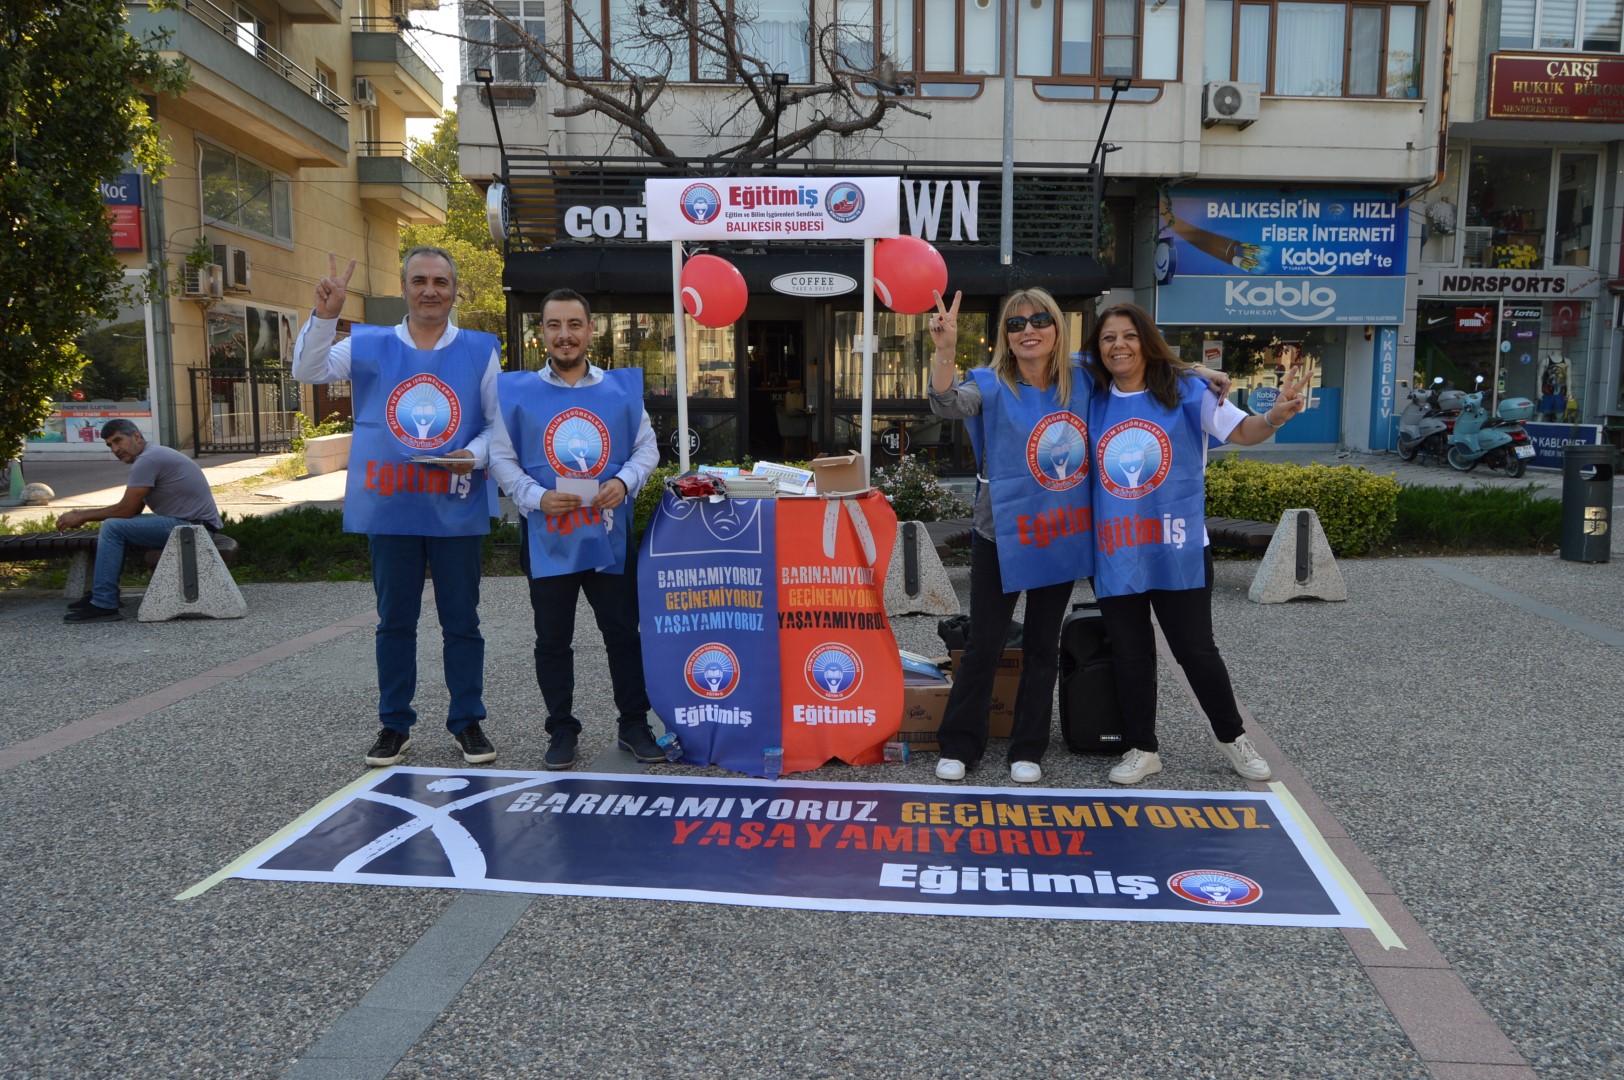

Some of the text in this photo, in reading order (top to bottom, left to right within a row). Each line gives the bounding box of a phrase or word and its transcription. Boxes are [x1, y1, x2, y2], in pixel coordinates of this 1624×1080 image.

[1546, 61, 1599, 80] ÇARŞI
[1512, 81, 1564, 94] HUKUK
[1502, 105, 1546, 113] MENDERES
[1520, 97, 1554, 105] AVUKAT
[729, 185, 818, 210] Eğitimiş
[725, 211, 743, 219] Eğitim
[1207, 198, 1396, 219] BALIKESİR'İN HIZLI
[564, 205, 647, 239] COF
[726, 218, 824, 234] BALIKESİR ŞUBESİ
[1261, 223, 1395, 242] FİBER İNTERNETİ
[791, 277, 835, 286] COFFEE
[1442, 275, 1566, 294] NDRSPORTS
[1224, 280, 1337, 307] Kablo
[1459, 319, 1482, 327] PUMA
[1380, 340, 1393, 419] KABLOTV
[1256, 391, 1277, 399] Kablo
[657, 566, 763, 588] BARINAMIYORUZ
[665, 586, 764, 611] GEÇİNEMİYORUZ
[654, 611, 765, 634] YAŞAYAMIYORUZ
[674, 704, 752, 728] Eğitimiş
[793, 704, 877, 727] Eğitimiş
[505, 792, 1271, 829] BARINAMIYORUZ GEÇİNEMİYORUZ
[879, 862, 1160, 900] Eğitimiş
